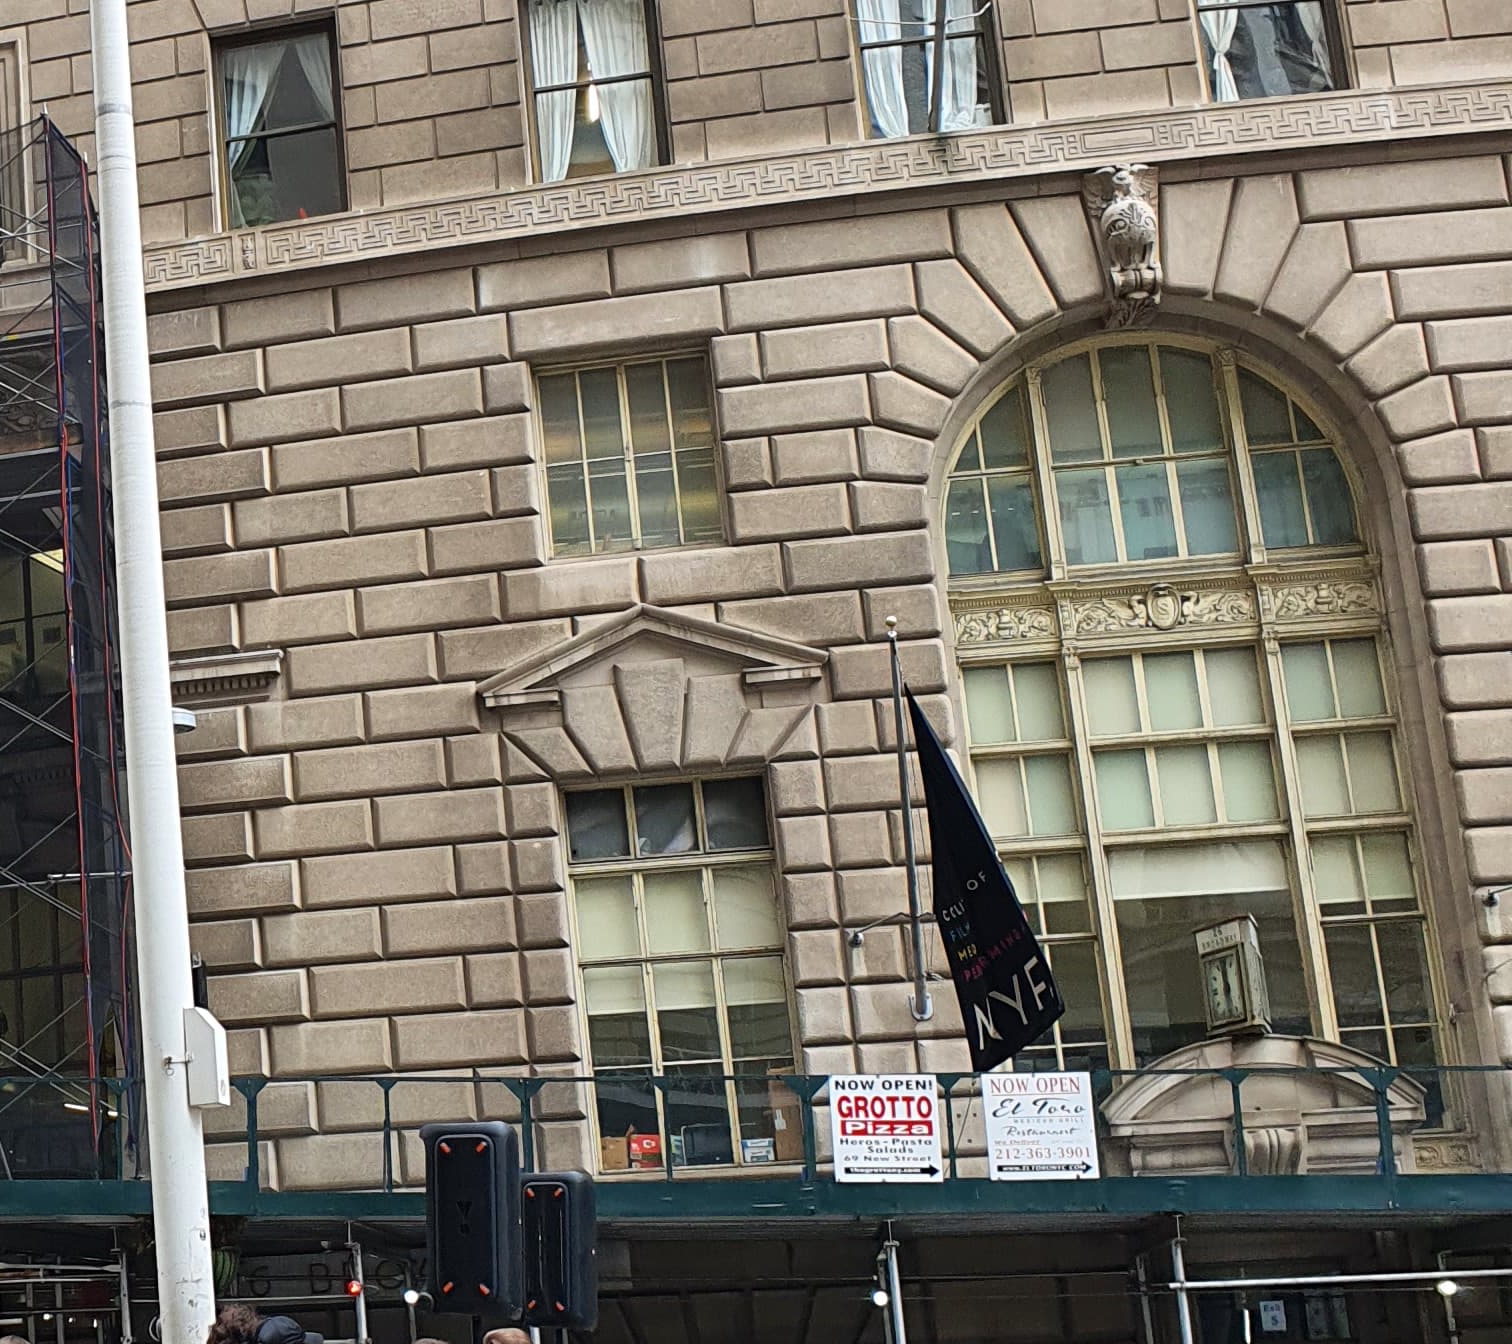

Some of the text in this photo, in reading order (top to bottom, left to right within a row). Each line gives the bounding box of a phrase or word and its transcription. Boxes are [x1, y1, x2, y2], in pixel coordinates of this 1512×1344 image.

[966, 871, 987, 891] OF
[973, 956, 1054, 1051] NYF
[834, 1079, 933, 1090] NOW OPEN!
[990, 1076, 1081, 1094] NOW OPEN
[837, 1095, 933, 1119] GROTTO
[992, 1097, 1024, 1118] El
[844, 1121, 929, 1135] Pizza
[867, 1146, 914, 1154] Salads
[994, 1146, 1091, 1160] 212-363-3901
